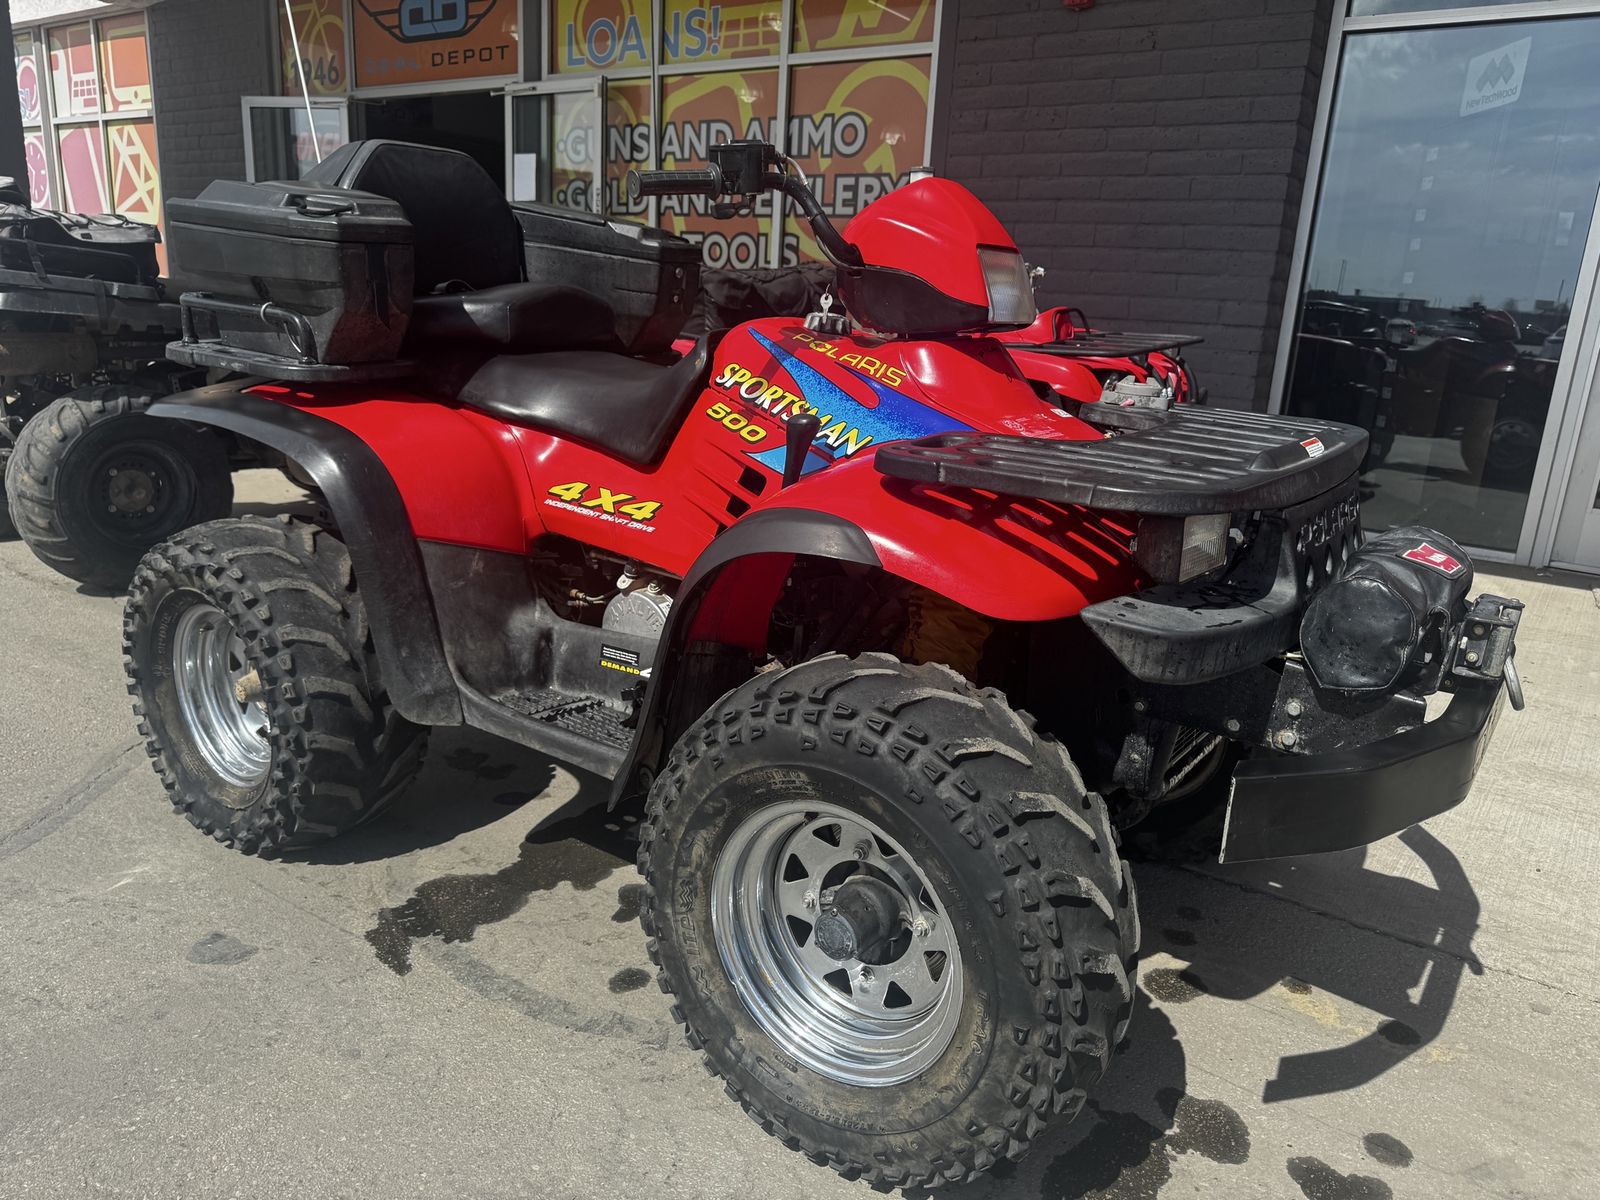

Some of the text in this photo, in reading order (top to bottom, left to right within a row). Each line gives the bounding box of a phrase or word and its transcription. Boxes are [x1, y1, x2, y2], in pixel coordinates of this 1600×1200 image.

[431, 45, 510, 67] DEPOT
[566, 5, 721, 67] LOANS!
[291, 55, 340, 87] 1946
[660, 119, 736, 162] AND
[743, 112, 868, 159] AMMO
[565, 179, 650, 216] GOLD
[738, 174, 909, 217] ELERY
[680, 231, 800, 270] TOOLS
[792, 333, 907, 387] POLARIS
[706, 402, 768, 445] 500
[715, 363, 873, 458] SPORTSAN
[544, 498, 656, 533] INDEPENDENT SHAFT DRIVE
[547, 481, 663, 522] 4X4
[600, 659, 640, 675] DEMAND
